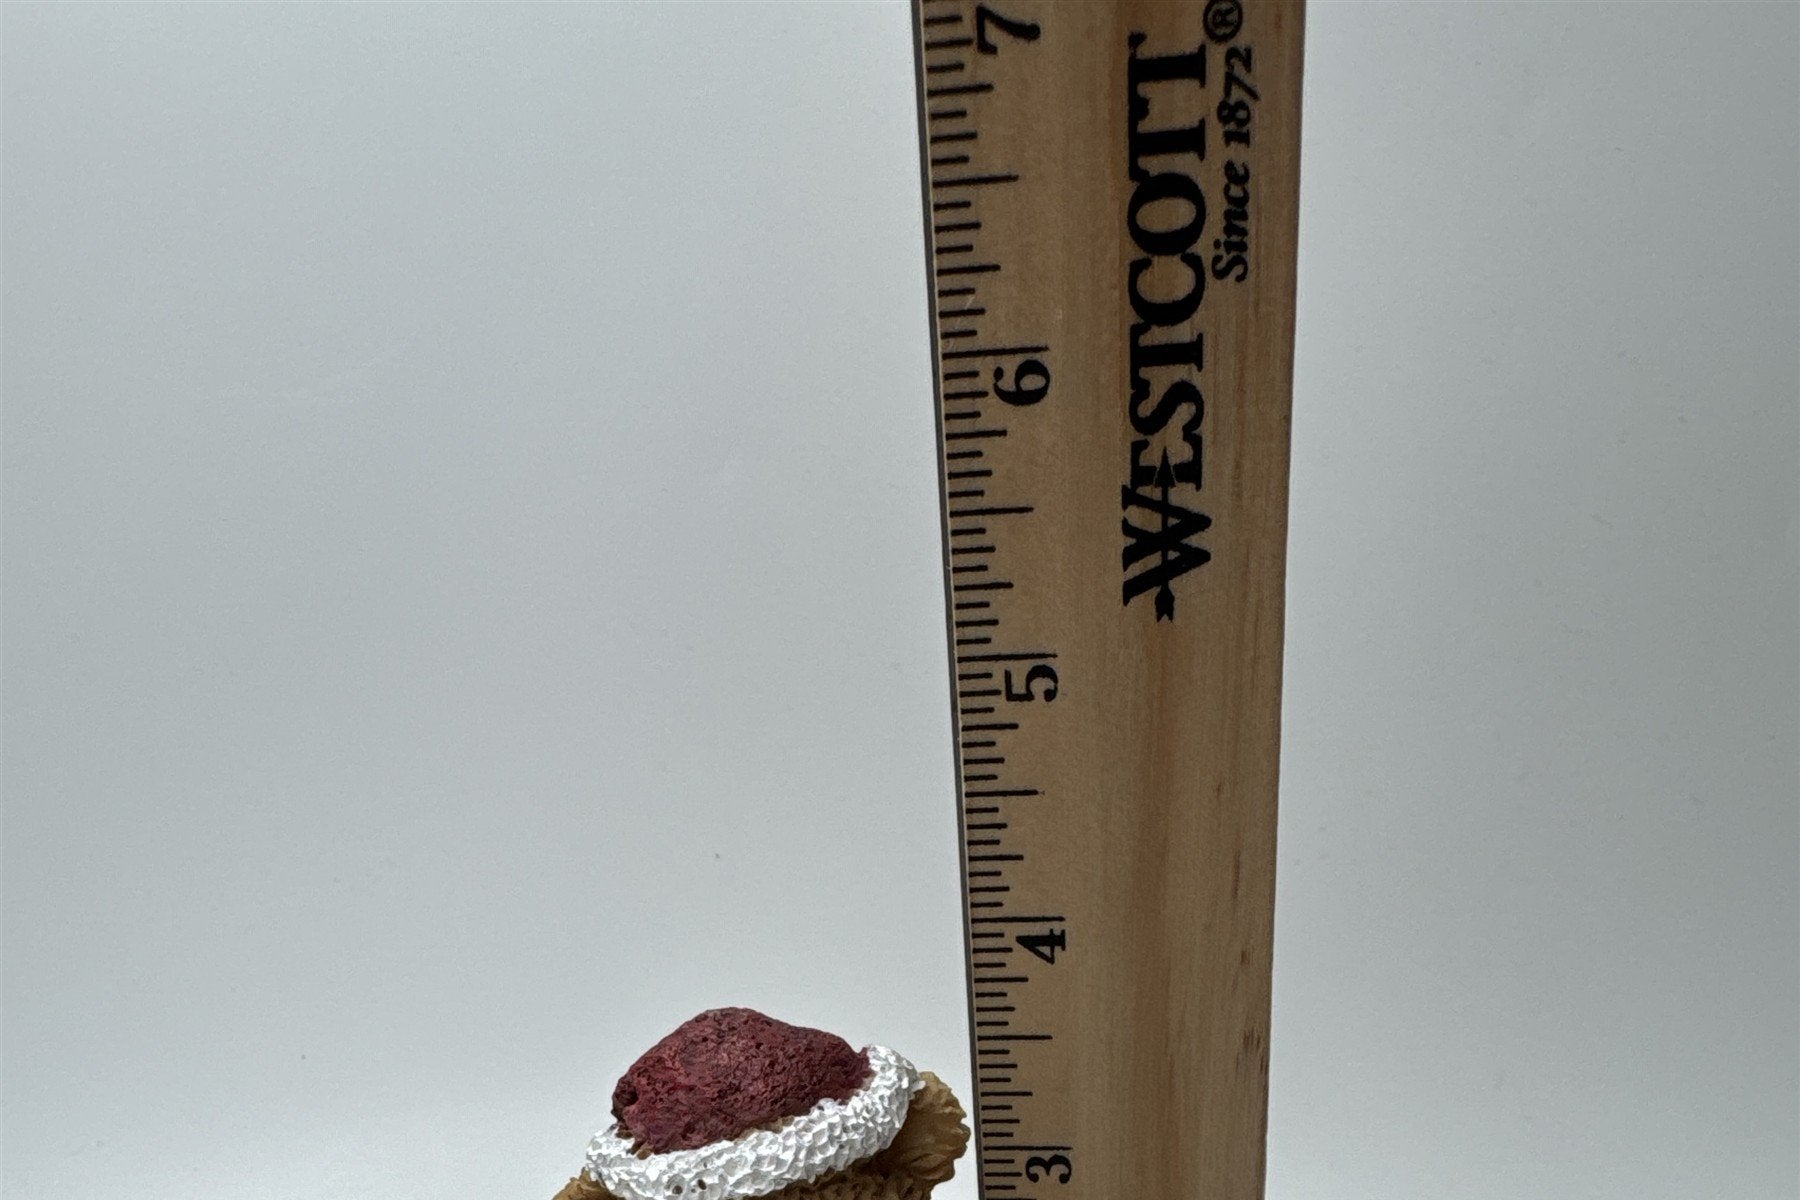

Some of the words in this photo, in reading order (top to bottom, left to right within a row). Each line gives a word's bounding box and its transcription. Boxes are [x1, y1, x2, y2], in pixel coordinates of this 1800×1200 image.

[974, 4, 1042, 55] 7
[1216, 45, 1260, 149] 1872
[1211, 160, 1252, 283] Since
[993, 358, 1051, 406] 6
[1004, 664, 1059, 702] 5
[1015, 928, 1067, 964] 4
[1025, 1154, 1073, 1184] 3
